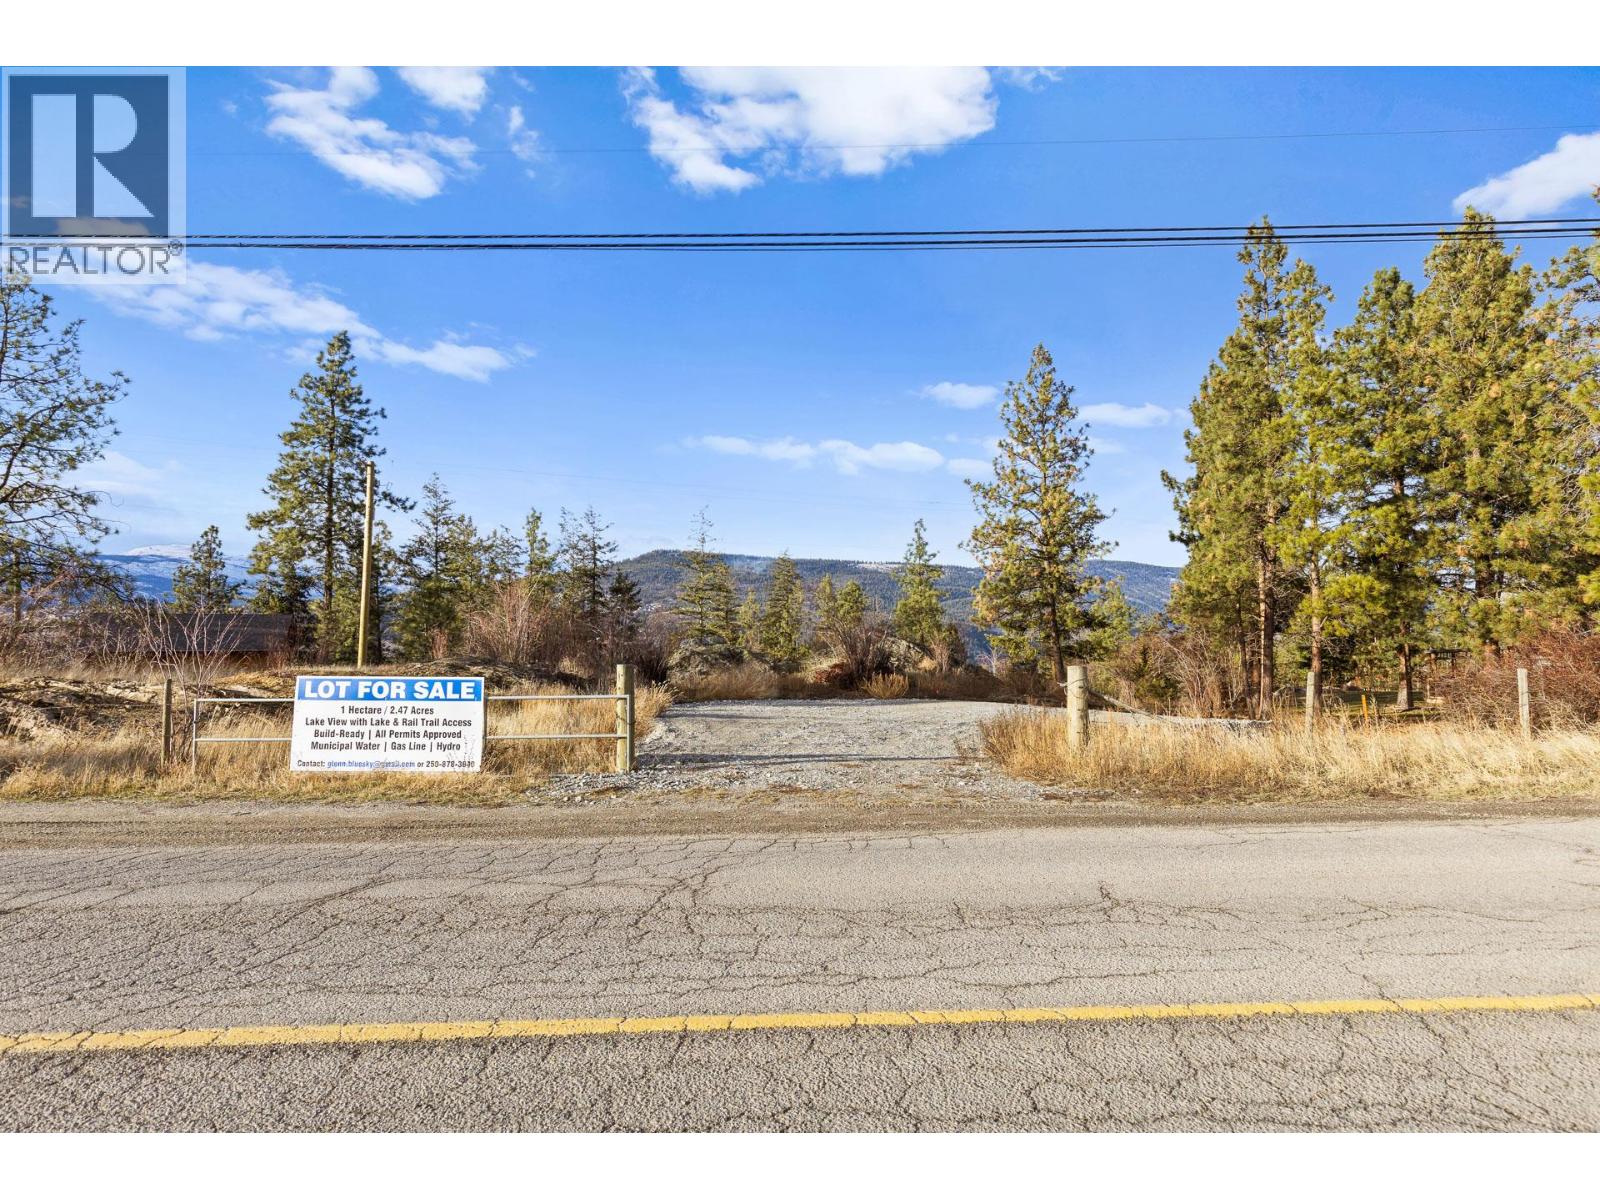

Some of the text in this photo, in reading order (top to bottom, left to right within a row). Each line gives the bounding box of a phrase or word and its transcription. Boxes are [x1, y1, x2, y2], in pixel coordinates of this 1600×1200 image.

[304, 680, 475, 699] LOT FOR SALE
[340, 705, 345, 714] 1
[348, 705, 382, 714] Hectare
[390, 705, 408, 715] 2.47
[410, 705, 435, 715] Acres
[305, 717, 472, 727] Lake View with Lake & Rail Trail Access
[314, 729, 365, 739] Build-Ready
[375, 729, 386, 738] All
[389, 729, 420, 739] Permits
[422, 729, 462, 740] Approved
[311, 741, 353, 751] Municipal
[355, 741, 381, 750] Water
[391, 741, 406, 751] Gas
[408, 741, 426, 751] Line
[436, 741, 461, 752] Hydro
